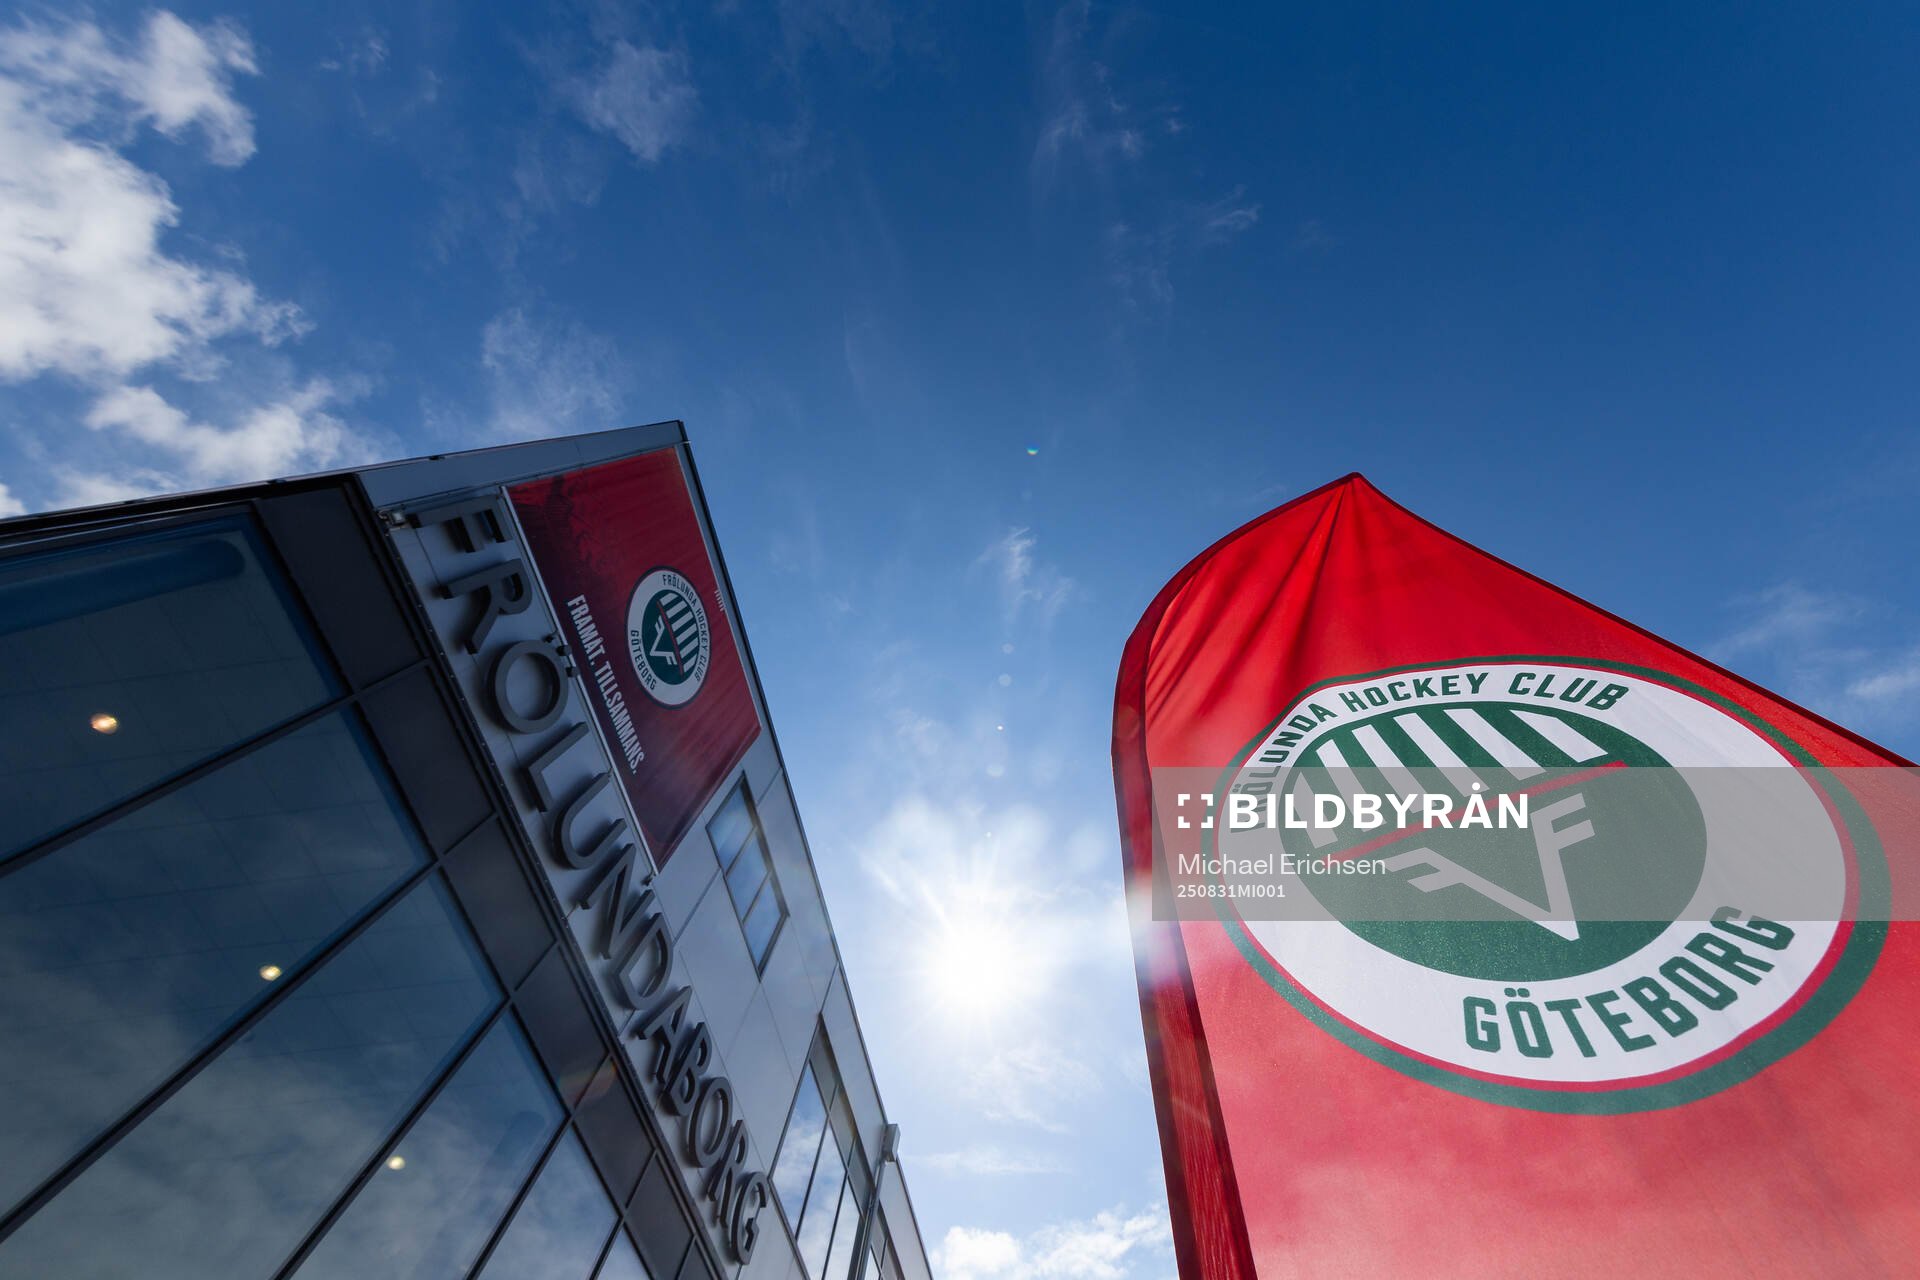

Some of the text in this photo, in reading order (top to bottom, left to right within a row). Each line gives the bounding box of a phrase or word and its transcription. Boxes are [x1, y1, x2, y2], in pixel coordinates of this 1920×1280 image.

[567, 594, 645, 775] FRAMÅT. TILLSAMMANS.
[630, 630, 657, 690] GÖTEBORG
[662, 573, 708, 682] FRÖLUNDA HOCKEY CLUB
[1230, 672, 1629, 833] ÖLUNDA HOCKEY CLUB
[1463, 906, 1795, 1059] GÖTEBORG
